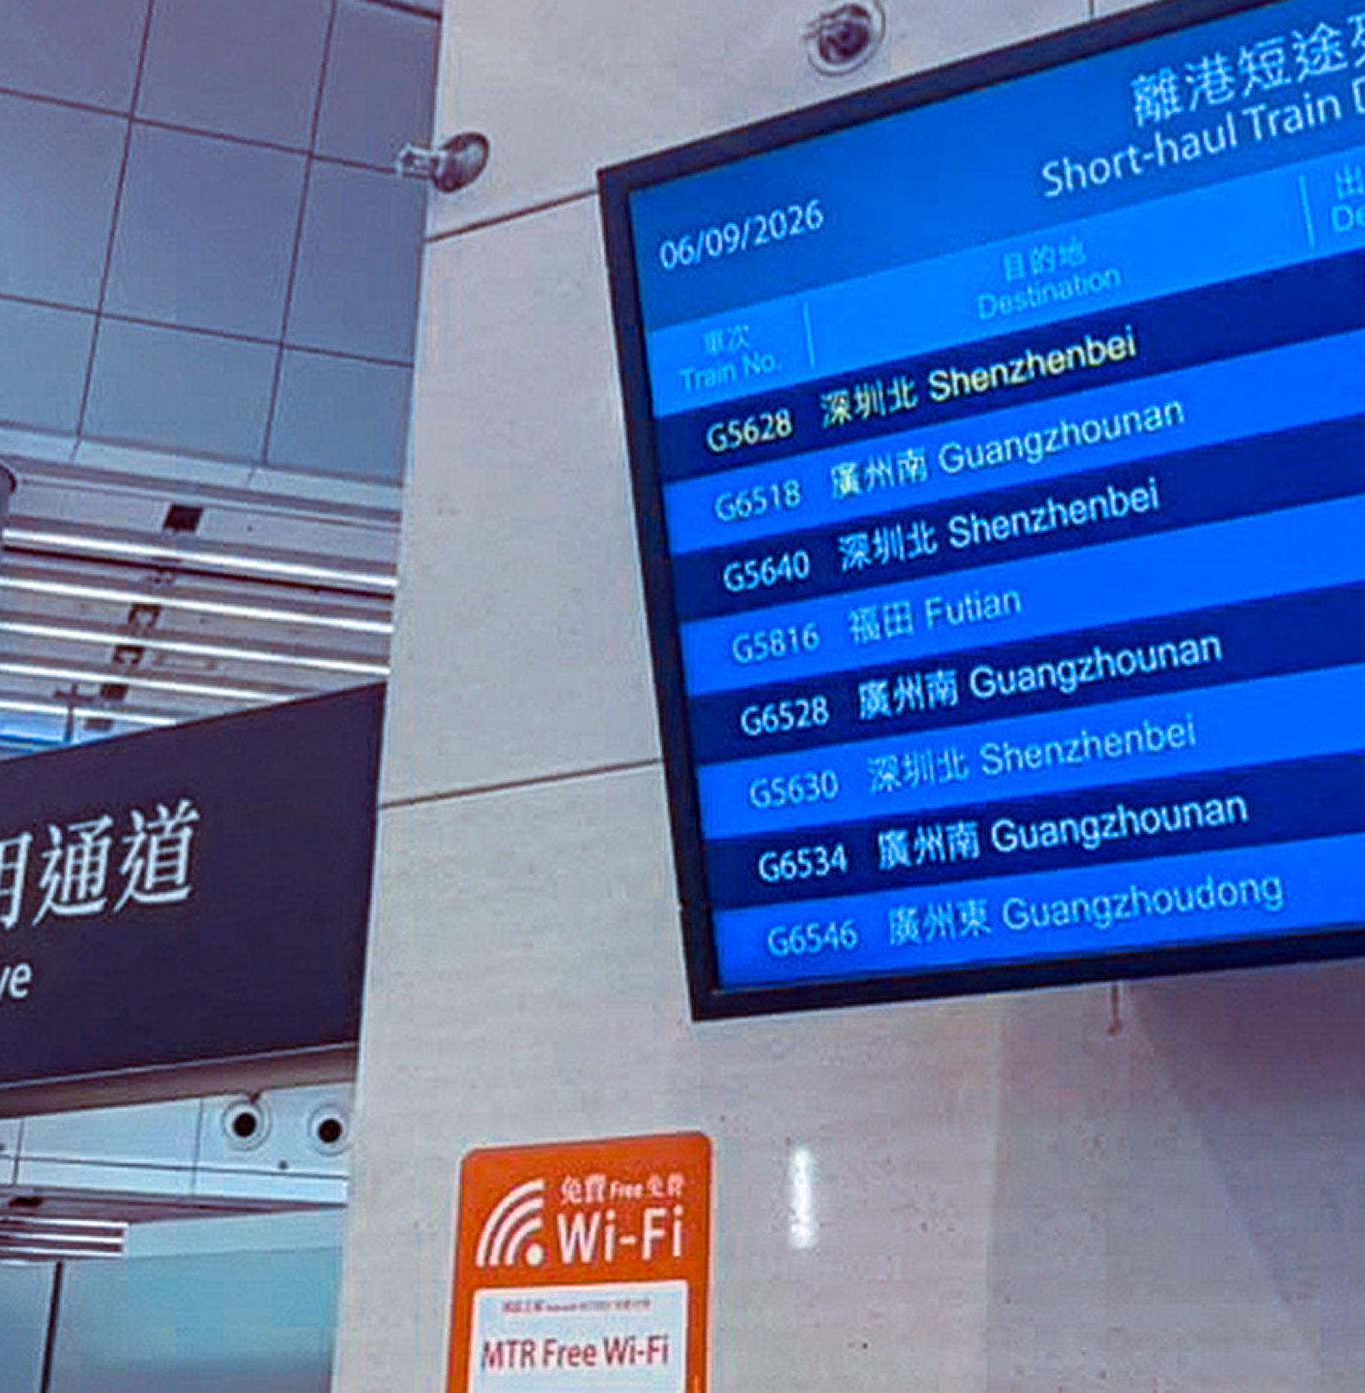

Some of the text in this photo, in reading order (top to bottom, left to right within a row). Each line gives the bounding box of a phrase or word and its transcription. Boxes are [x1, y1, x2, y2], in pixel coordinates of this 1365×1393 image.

[1041, 119, 1237, 197] Short-haul
[1243, 91, 1341, 142] Train
[660, 201, 824, 270] 06/09/2026
[1003, 234, 1086, 282] 目的地
[977, 268, 1121, 320] Destination
[680, 364, 735, 391] Train
[820, 325, 1136, 430] 深圳北 Shenzhenbei
[706, 408, 793, 453] G5628
[830, 399, 1185, 502] 廣州南 Guangzhounan
[714, 480, 802, 524] G6518
[838, 477, 1161, 575] 深圳北 Shenzhenbei
[722, 551, 811, 596] G5640
[847, 586, 1022, 647] 福田 Futian
[732, 625, 821, 666] G5816
[857, 630, 1224, 721] 廣州南 Guangzhounan
[741, 698, 830, 738] G6528
[868, 712, 1197, 796] 深圳北 Shenzhenbei
[749, 770, 839, 810] G5630
[877, 795, 1249, 871] 廣州南 Guangzhounan
[758, 845, 848, 885] G6534
[888, 872, 1284, 947] 廣州東 Guangzhoudong
[768, 920, 859, 958] G6546
[557, 1204, 683, 1264] Wi-Fi
[482, 1334, 669, 1370] MTR Free Wi-Fi
